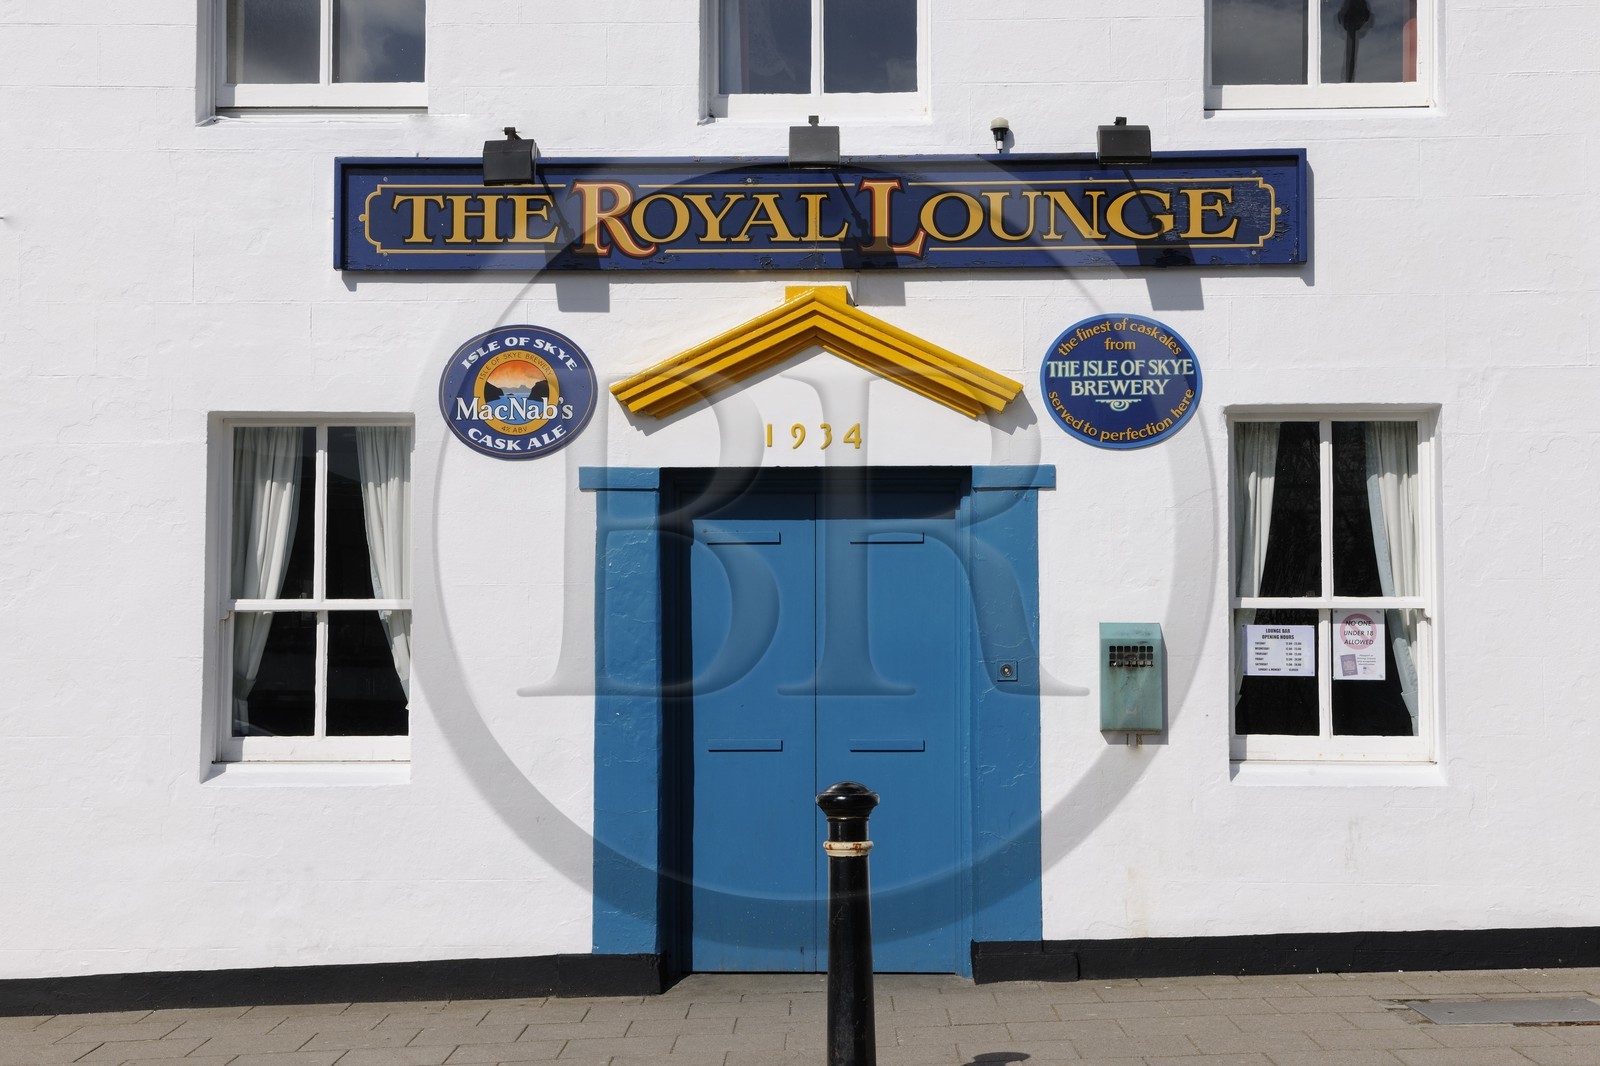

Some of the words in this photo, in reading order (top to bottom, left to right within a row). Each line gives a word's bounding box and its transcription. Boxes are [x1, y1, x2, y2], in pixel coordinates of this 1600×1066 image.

[392, 193, 559, 245] THE
[572, 178, 850, 258] ROYAL
[857, 177, 1240, 256] LOUNGE
[1058, 338, 1078, 356] the
[1077, 321, 1110, 341] finest
[1114, 318, 1129, 331] of
[1130, 324, 1161, 338] cask
[1159, 333, 1181, 355] ales
[1104, 338, 1136, 350] from
[461, 341, 500, 370] ISLE
[505, 337, 530, 346] OF
[534, 338, 577, 371] SKYE
[479, 365, 492, 380] ISLE
[492, 357, 500, 365] OF
[525, 353, 553, 376] BREWERY
[1046, 360, 1080, 378] THE
[1083, 360, 1118, 377] ISLE
[1121, 360, 1145, 376] OF
[1148, 359, 1194, 375] SKYE
[1071, 379, 1171, 396] BREWERY
[456, 396, 574, 421] MacNab's
[1049, 391, 1084, 429] served
[1083, 422, 1098, 436] to
[1100, 417, 1173, 442] perfection
[1170, 389, 1194, 418] here
[468, 428, 521, 451] CASK
[527, 424, 567, 450] ALE
[767, 423, 862, 449] 1934
